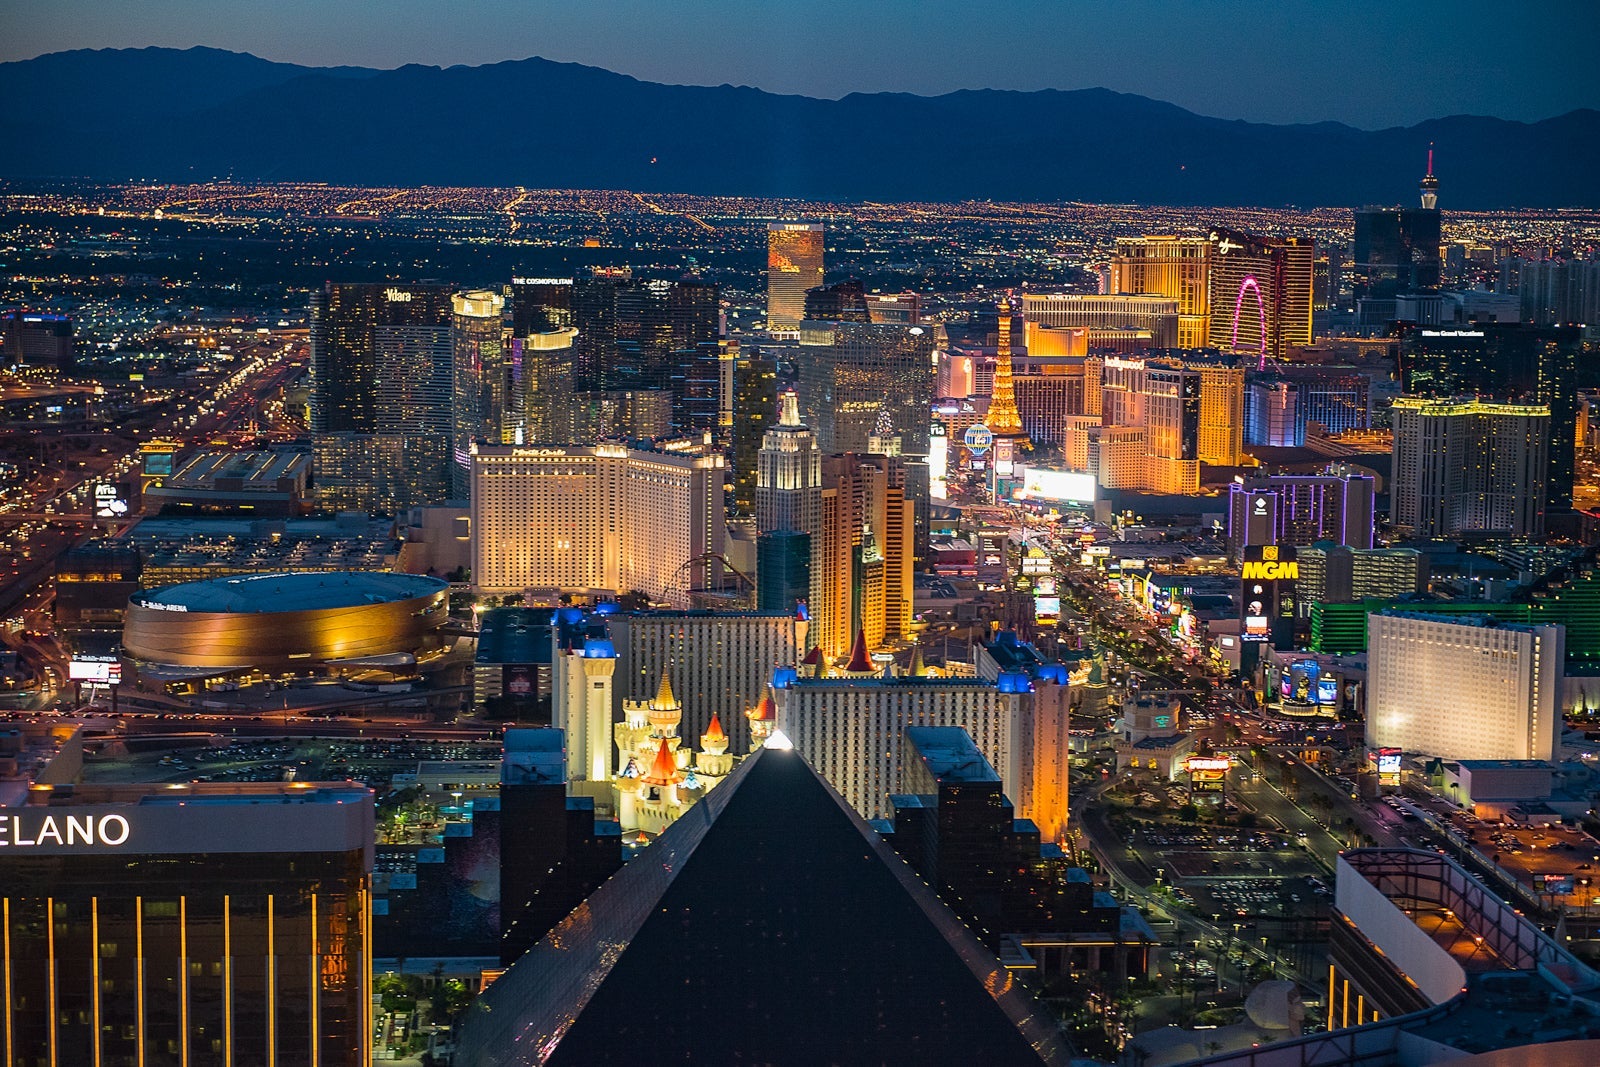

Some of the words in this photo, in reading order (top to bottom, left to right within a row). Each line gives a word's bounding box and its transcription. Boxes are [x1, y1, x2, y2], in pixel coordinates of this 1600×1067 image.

[386, 287, 411, 302] Vdara
[1104, 355, 1145, 371] hollywood
[540, 449, 567, 457] Carlo
[95, 484, 117, 496] Aria
[1242, 561, 1299, 580] MGM
[166, 604, 188, 612] ARENA
